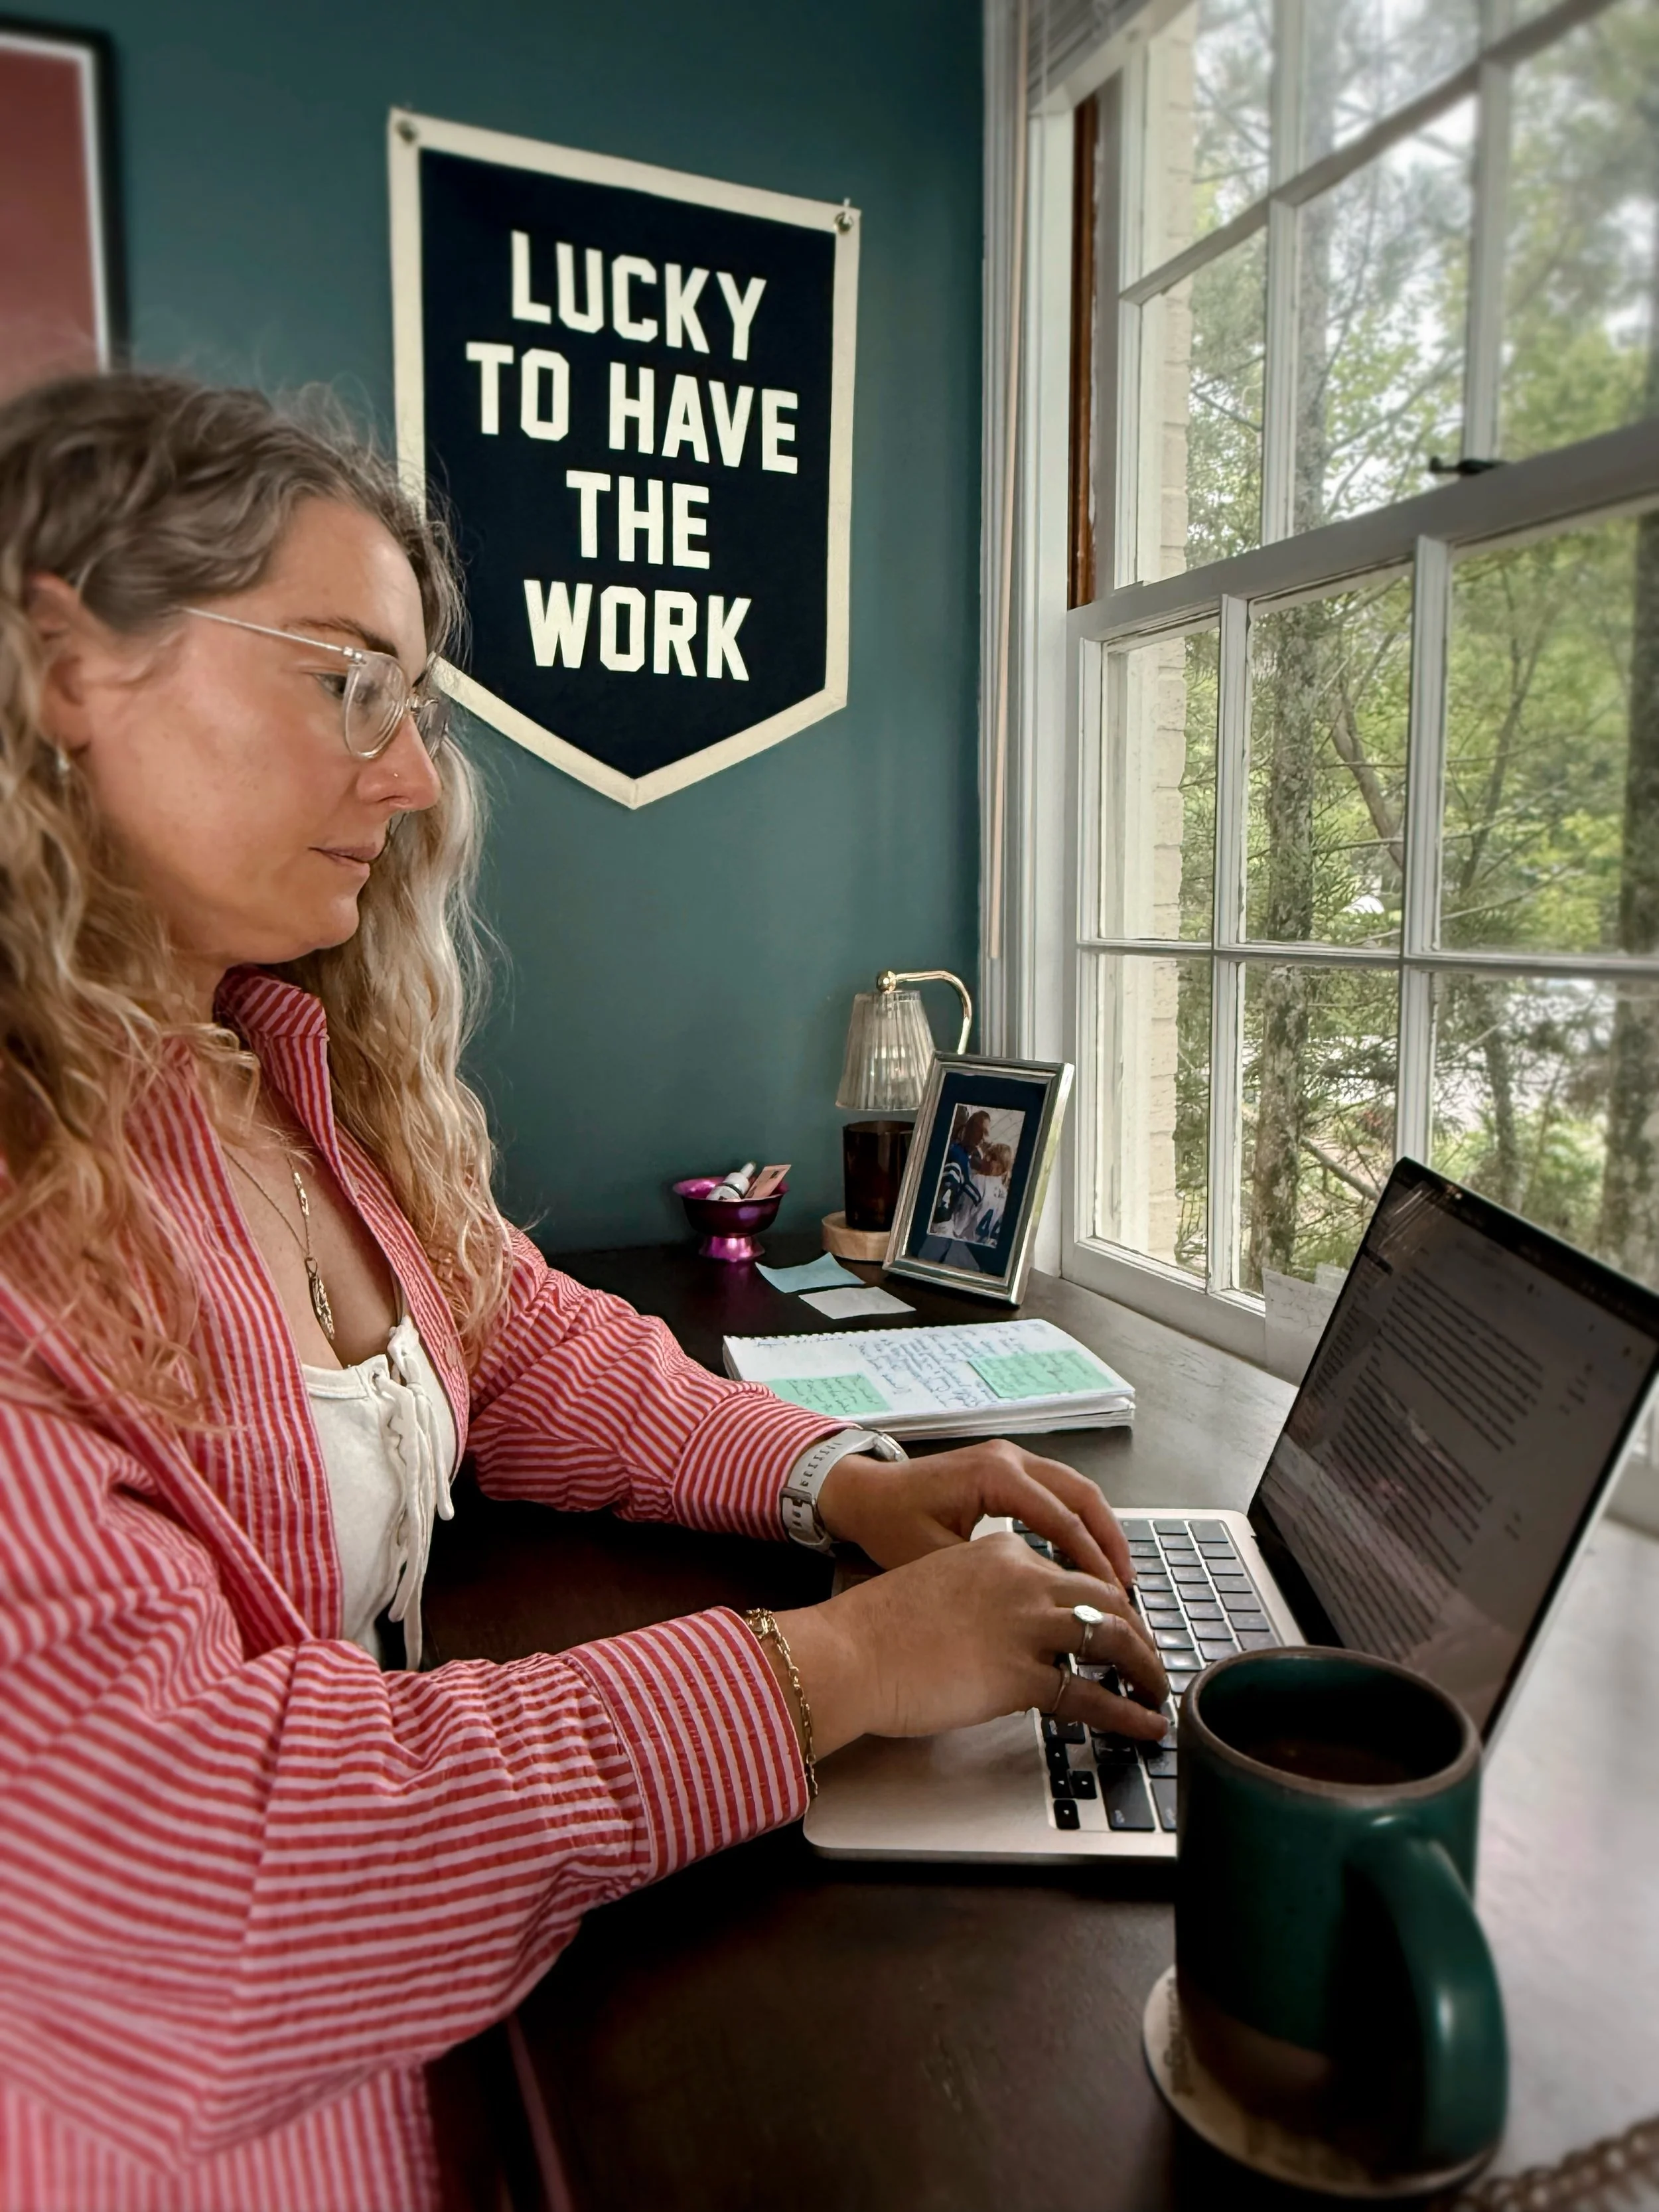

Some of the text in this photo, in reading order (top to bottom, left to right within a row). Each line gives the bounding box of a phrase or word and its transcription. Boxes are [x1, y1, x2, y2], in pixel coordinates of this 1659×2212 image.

[512, 230, 766, 361] LUCKY
[466, 342, 798, 475] TO HAVE
[565, 469, 710, 569] THE
[524, 579, 752, 682] WORK
